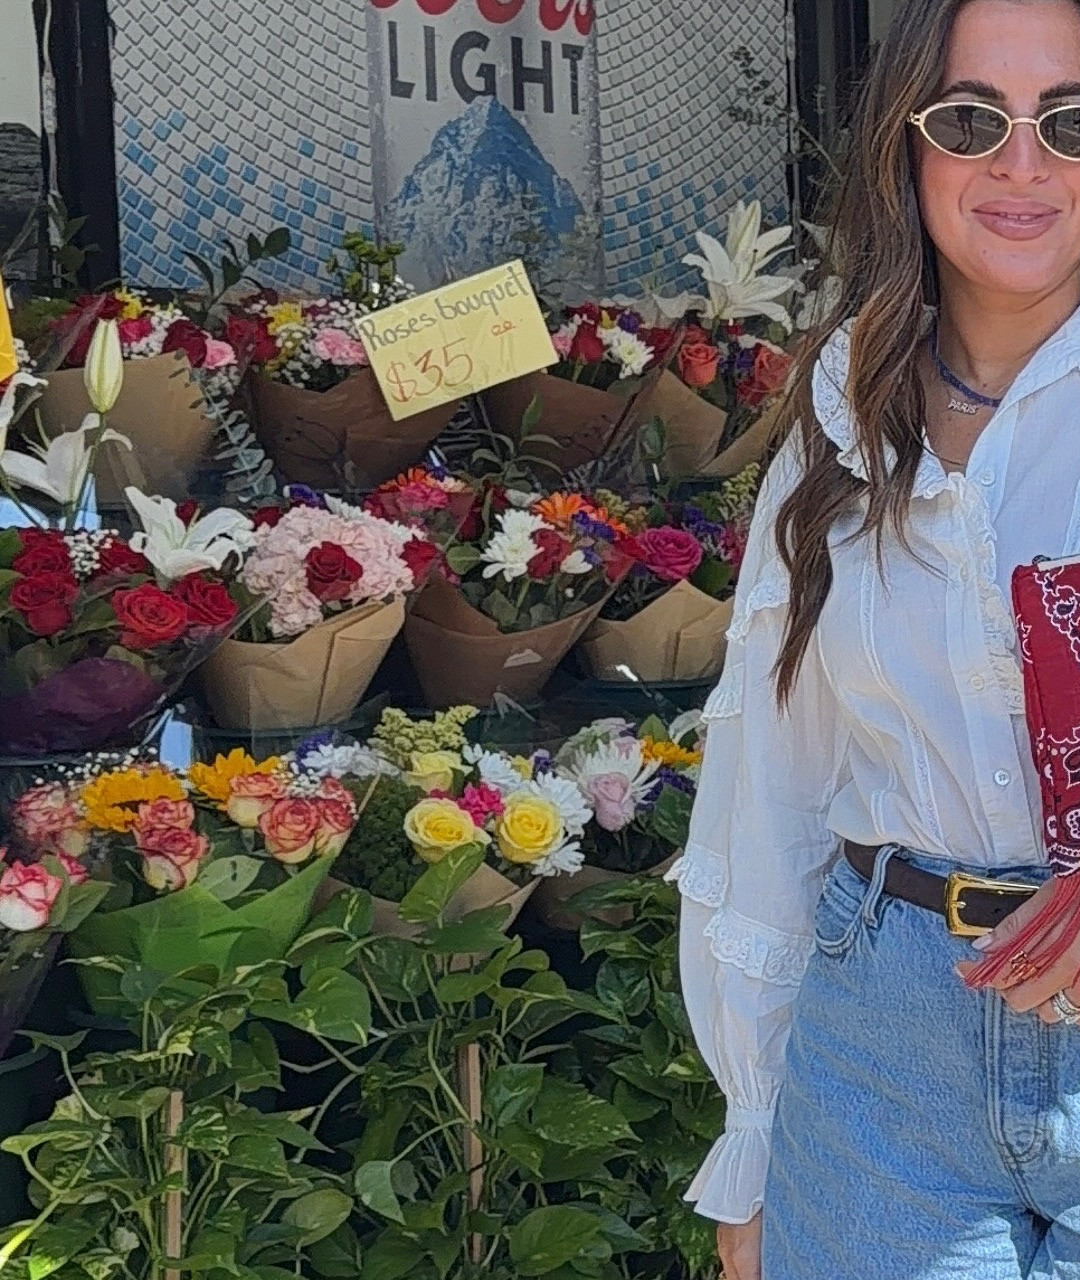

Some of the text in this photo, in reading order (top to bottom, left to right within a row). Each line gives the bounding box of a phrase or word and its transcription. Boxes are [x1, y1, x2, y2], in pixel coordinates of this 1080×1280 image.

[388, 20, 585, 115] LIGHT
[361, 265, 530, 351] Roses bouquet
[386, 337, 473, 403] $35
